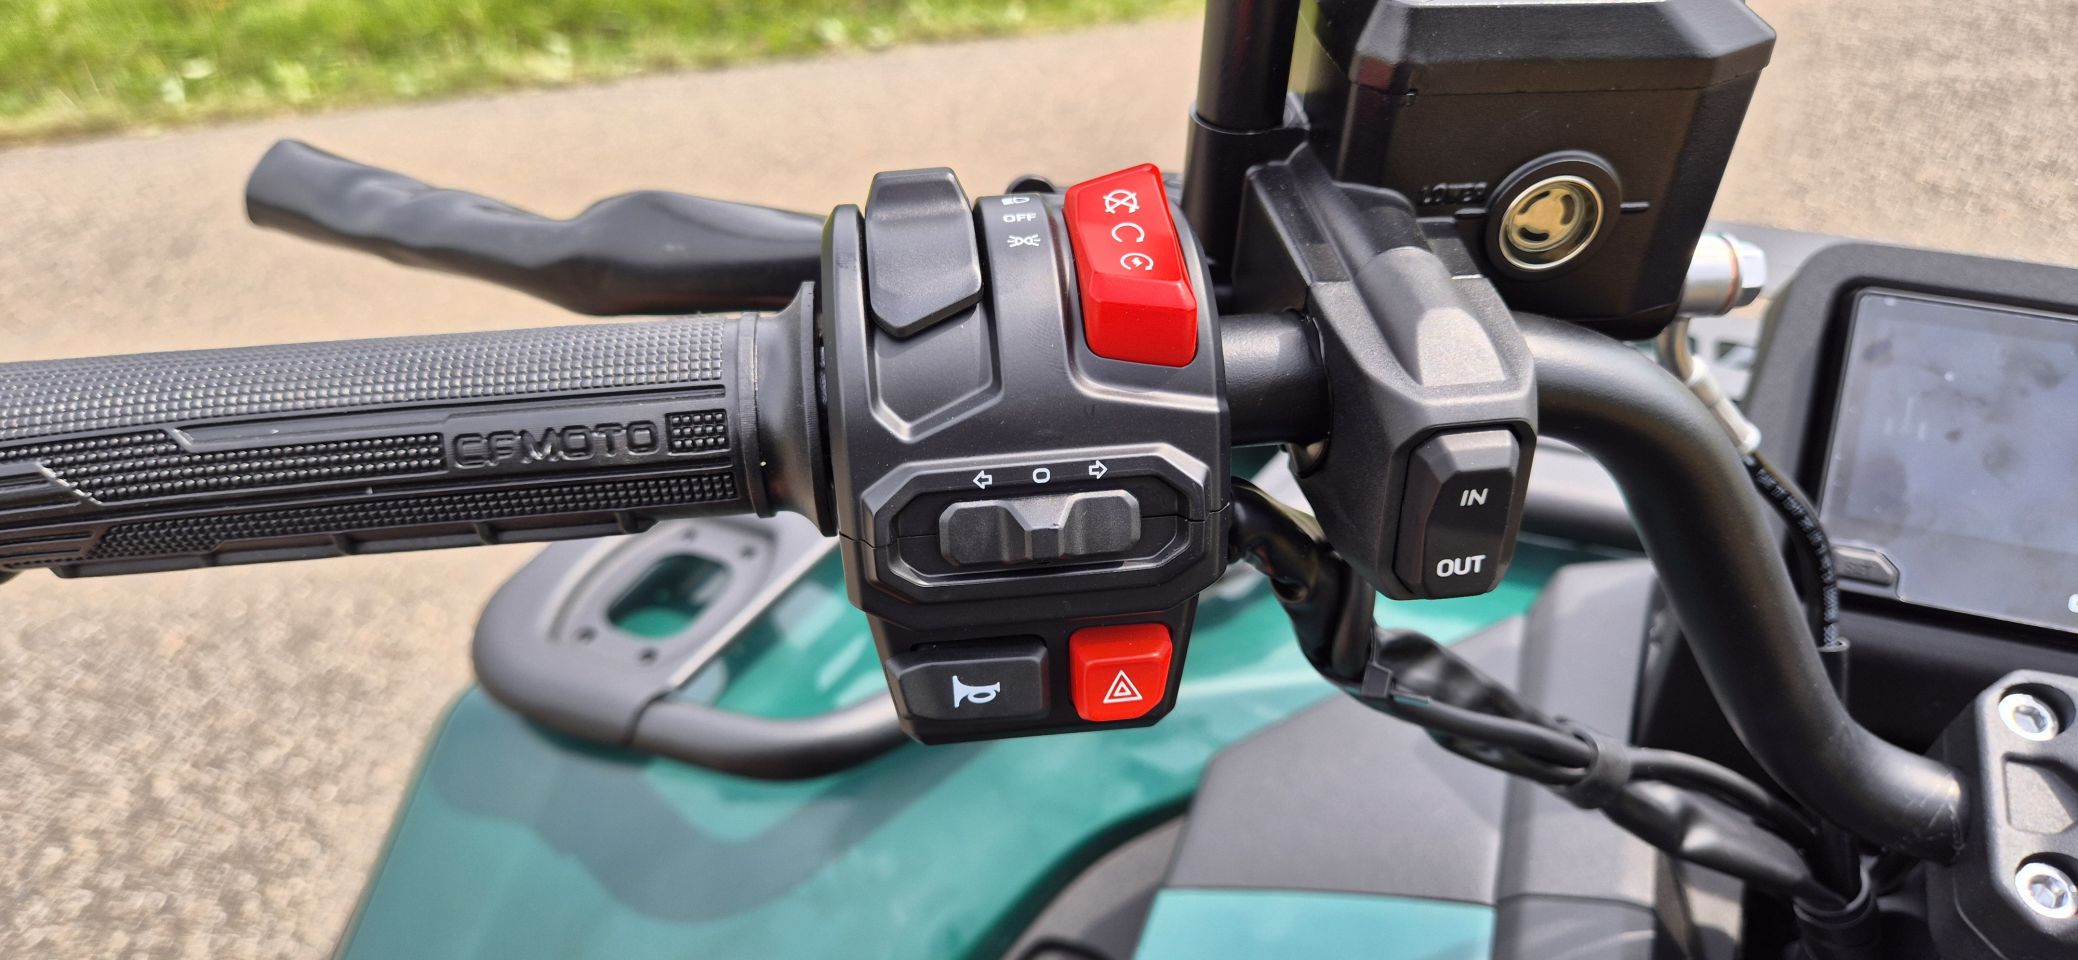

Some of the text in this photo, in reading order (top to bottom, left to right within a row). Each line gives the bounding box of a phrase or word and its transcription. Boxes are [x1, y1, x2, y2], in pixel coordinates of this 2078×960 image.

[1002, 212, 1037, 223] OFF
[452, 419, 660, 469] CFMOTO
[1459, 487, 1489, 507] IN
[1436, 554, 1486, 578] OUT
